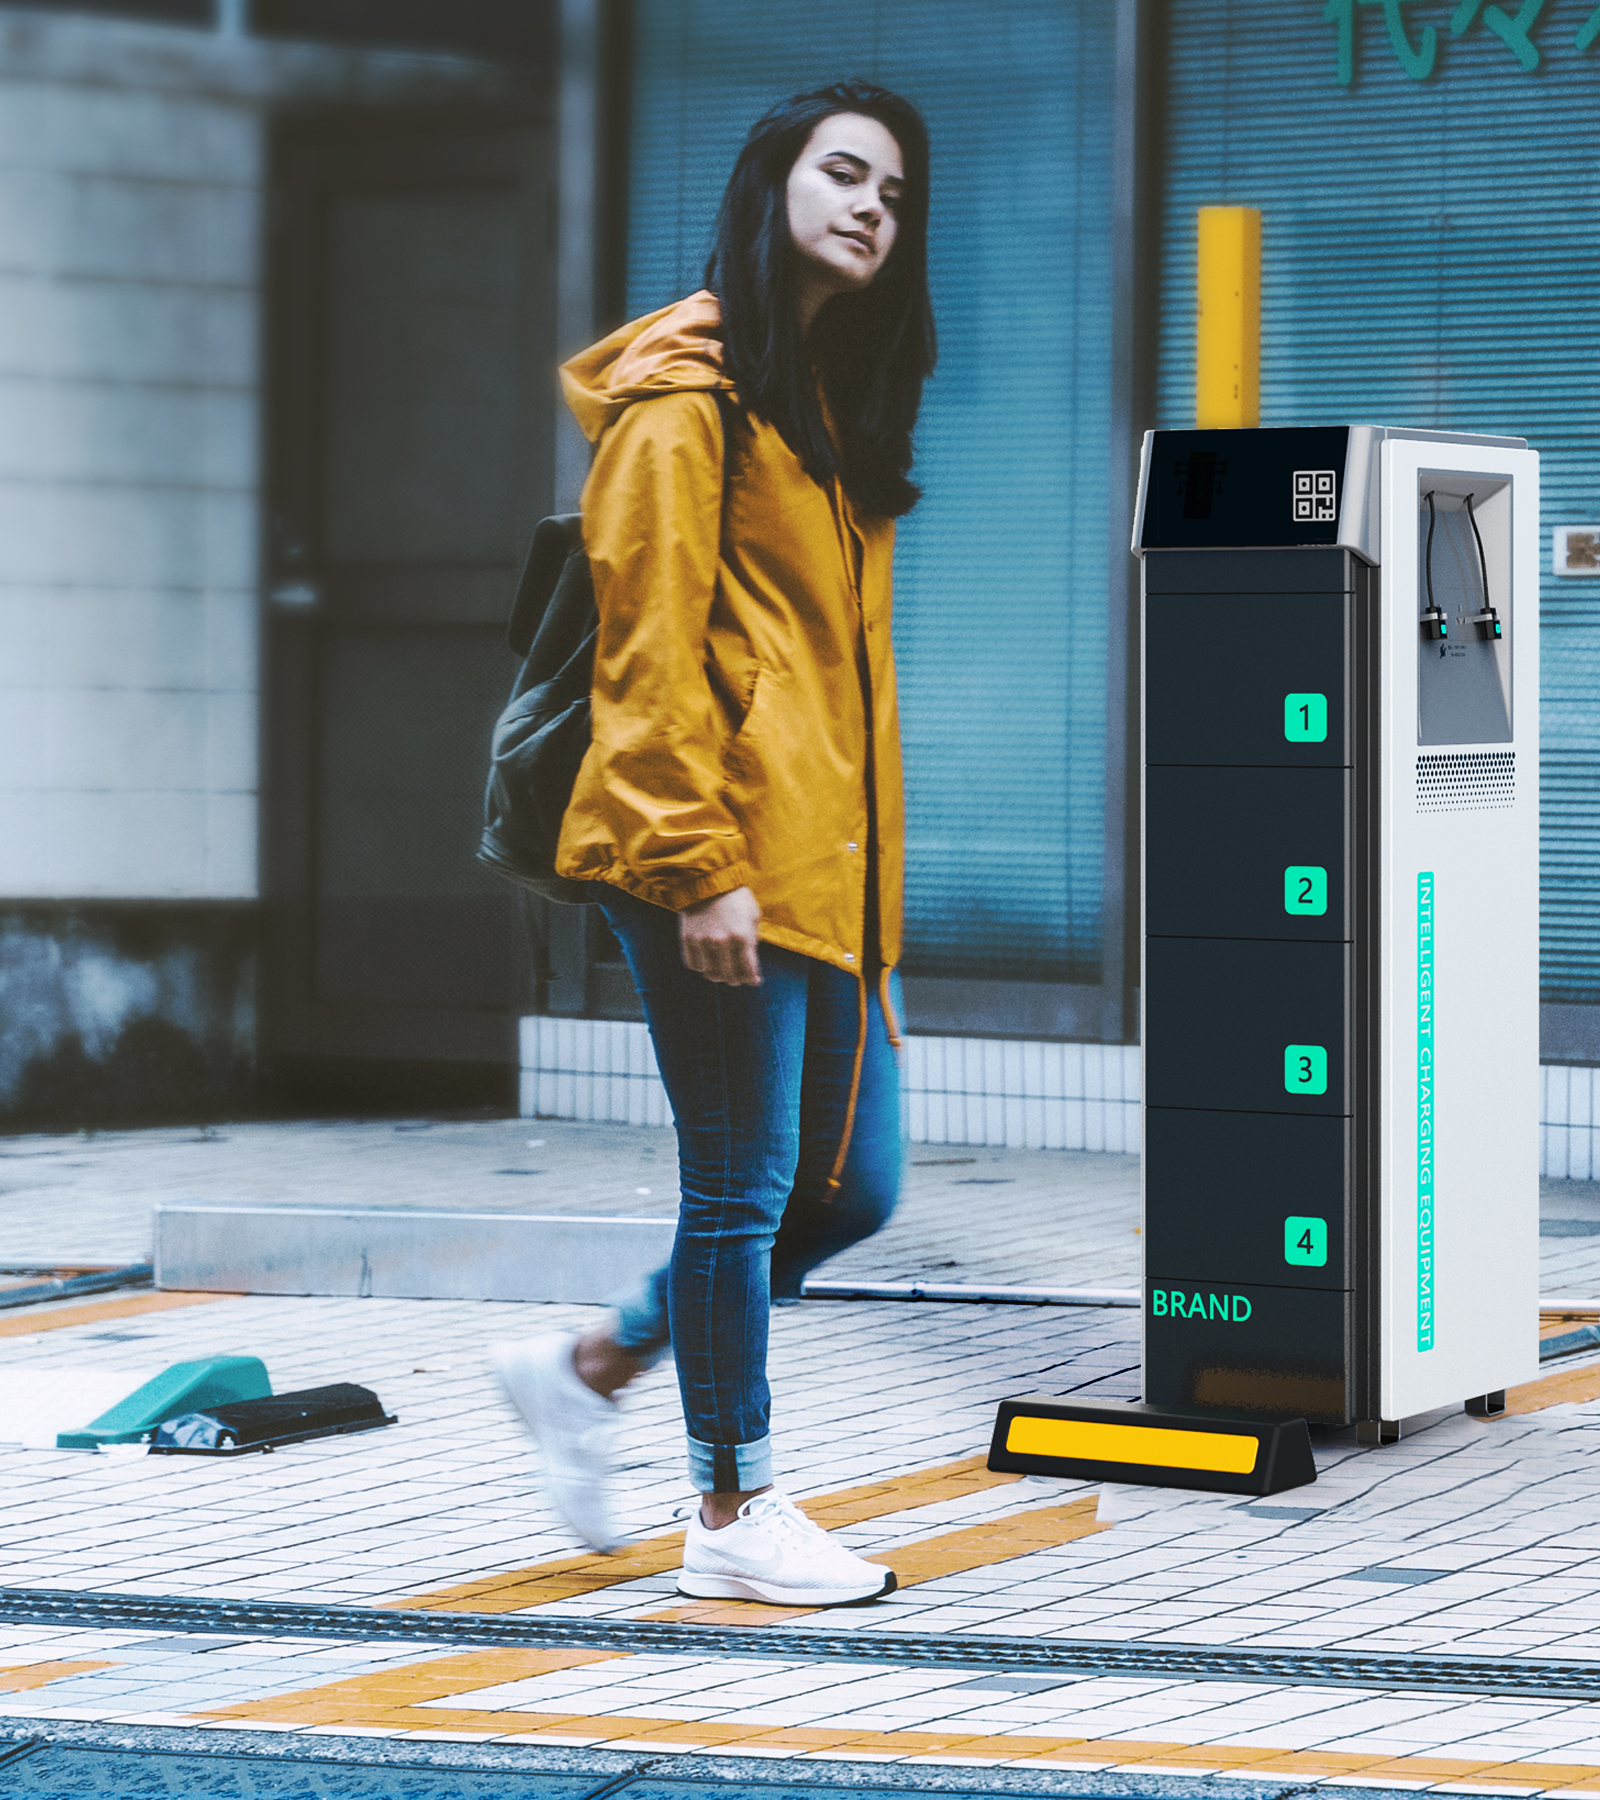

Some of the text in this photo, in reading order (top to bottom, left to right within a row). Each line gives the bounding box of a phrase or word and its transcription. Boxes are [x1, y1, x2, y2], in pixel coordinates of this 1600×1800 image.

[1299, 704, 1309, 731] 1
[1297, 876, 1313, 904] 2
[1298, 1055, 1313, 1083] 3
[1419, 877, 1432, 1345] INTELLIGENT CHARGING EQUIPMENT
[1296, 1228, 1314, 1255] 4
[1152, 1289, 1252, 1322] BRAND
